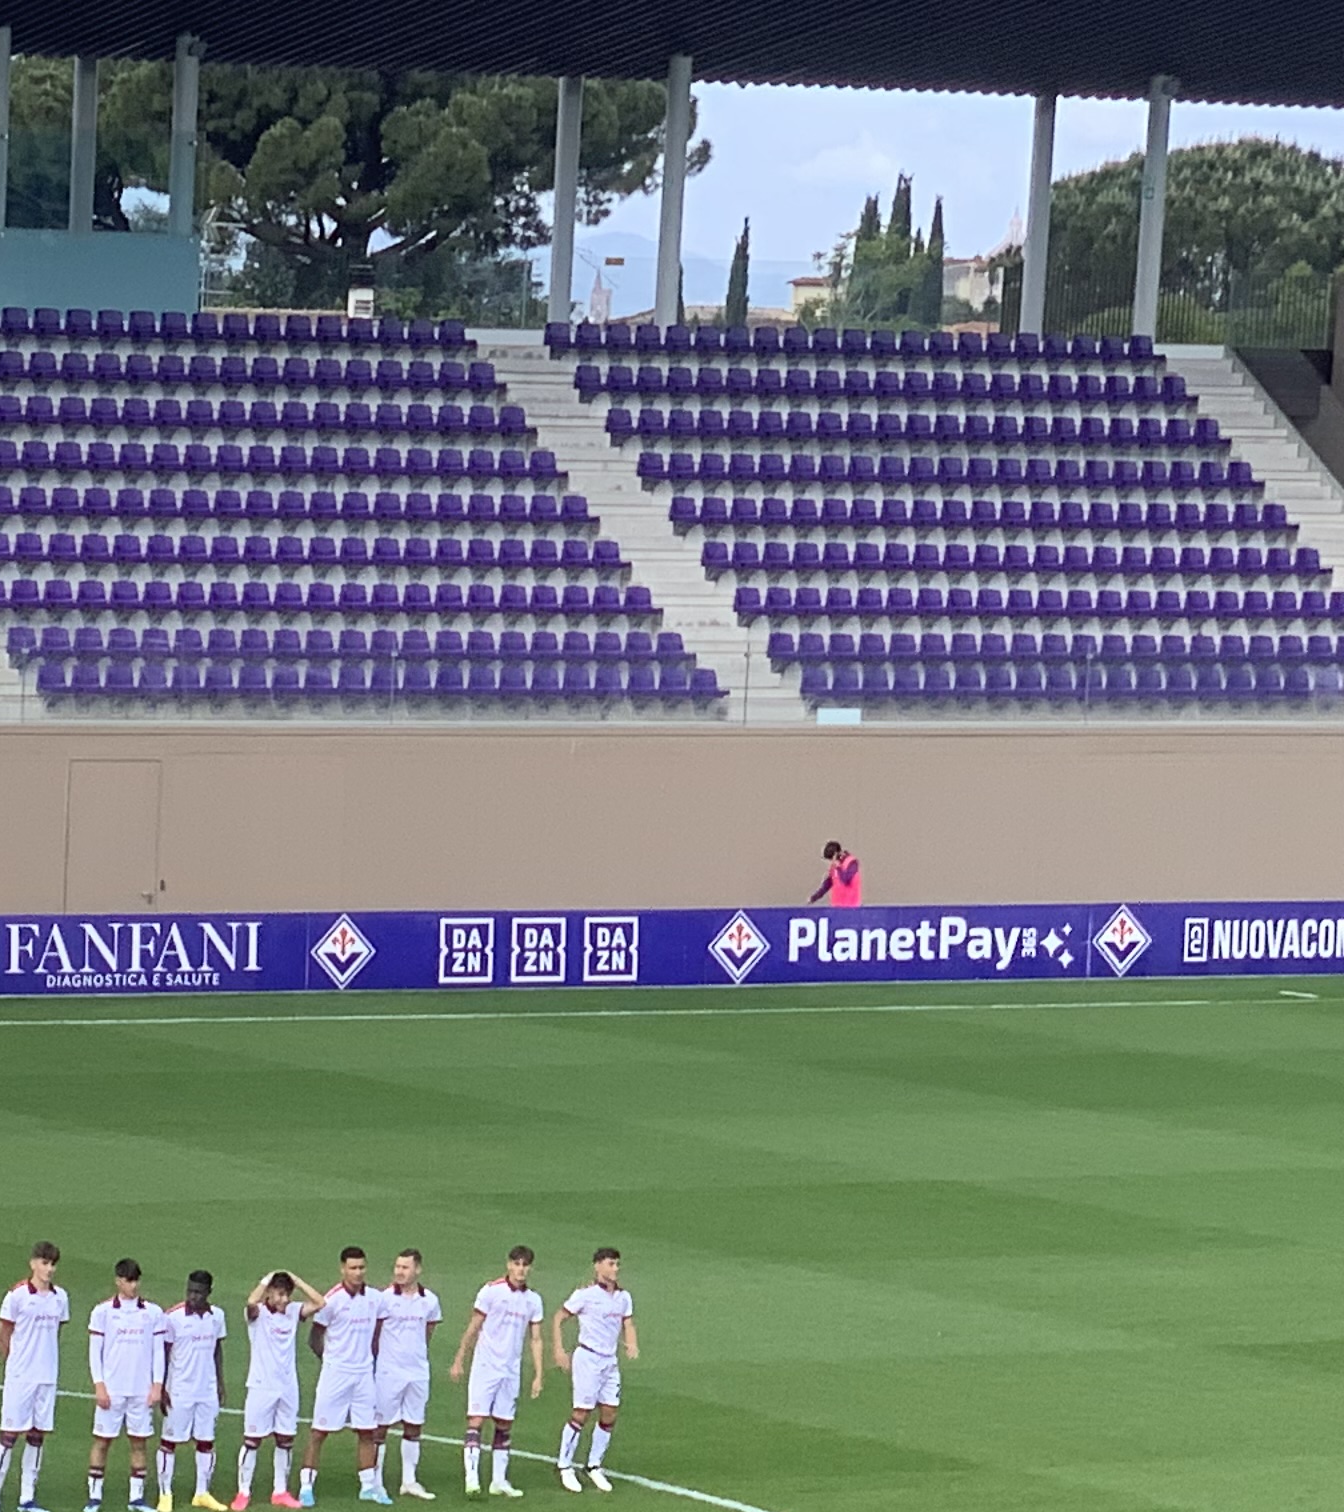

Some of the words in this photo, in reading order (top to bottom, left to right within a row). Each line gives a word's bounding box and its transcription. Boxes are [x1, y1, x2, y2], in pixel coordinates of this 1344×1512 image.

[4, 921, 262, 974] FANFANI
[789, 916, 1022, 971] PlanetPay
[46, 972, 148, 988] DIAGNOSTICA
[152, 971, 161, 986] E
[165, 972, 220, 986] SALUTE
